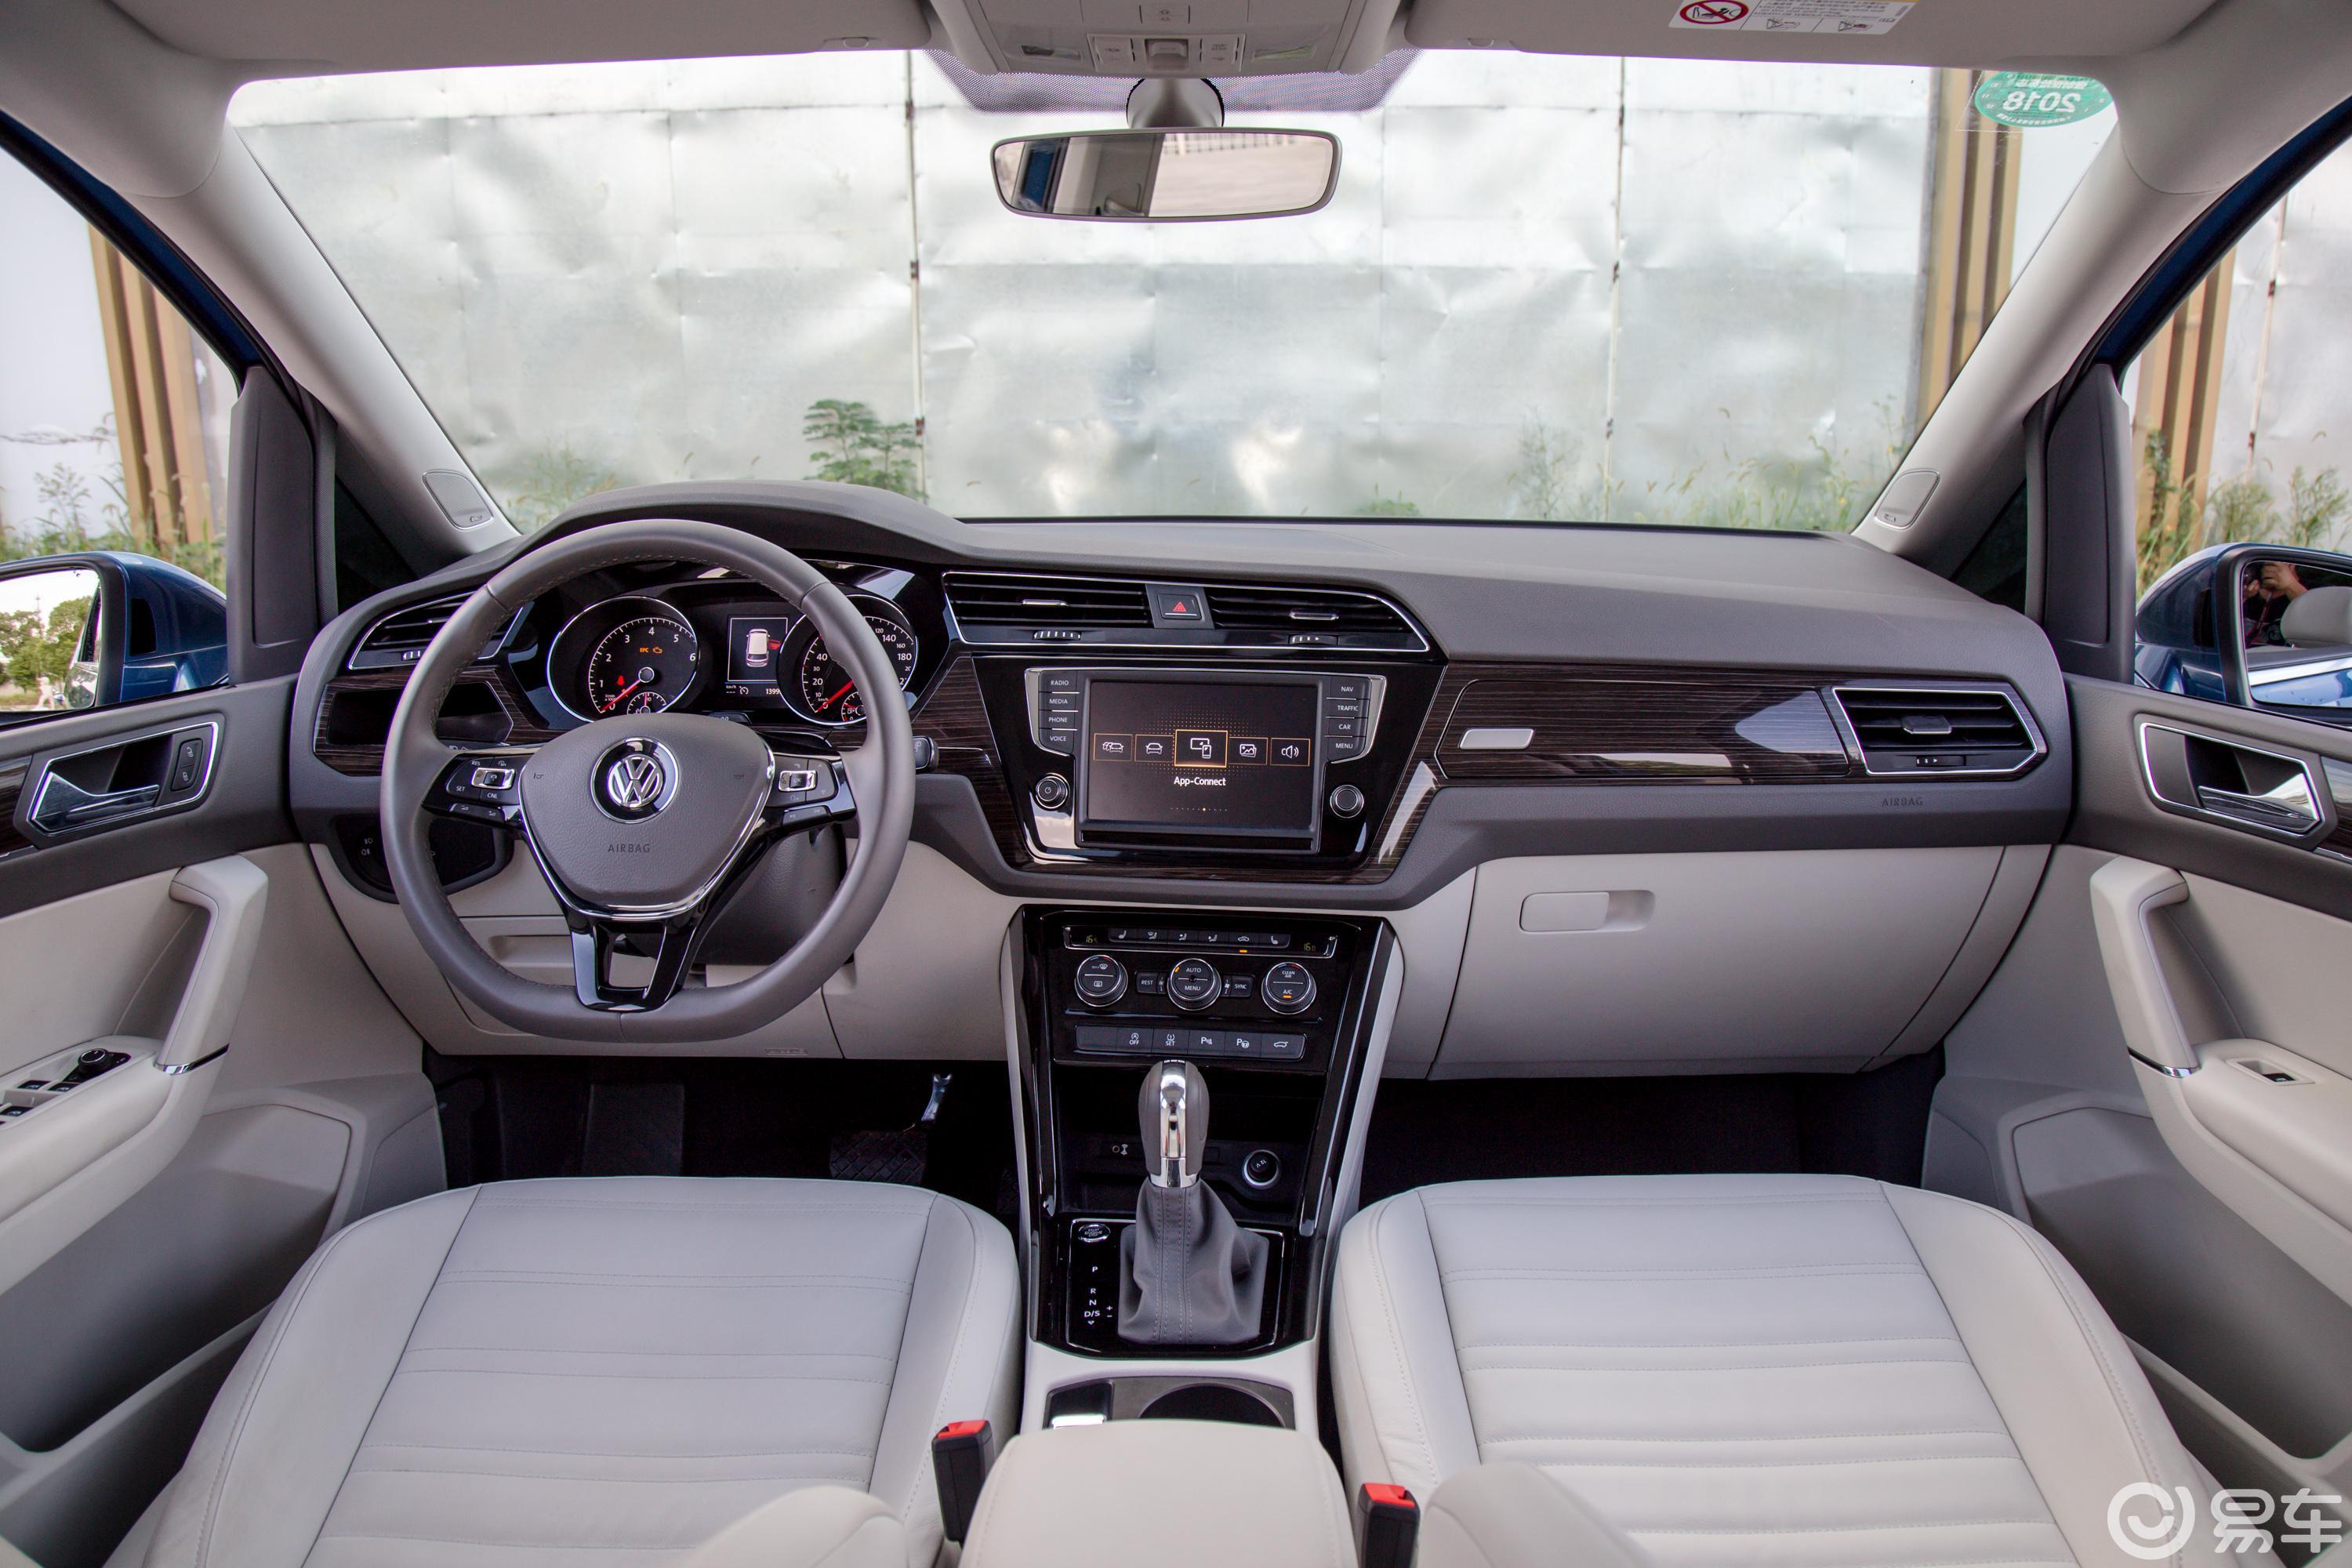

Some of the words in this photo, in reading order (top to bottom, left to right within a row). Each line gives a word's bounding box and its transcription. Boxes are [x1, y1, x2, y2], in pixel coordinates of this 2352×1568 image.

[648, 627, 655, 636] 4
[625, 634, 630, 643] 3
[673, 634, 679, 643] 5
[605, 654, 612, 662] 2
[1174, 776, 1227, 787] App-Connect
[1881, 797, 1923, 807] AIRBAG
[608, 844, 651, 853] AIRBAG
